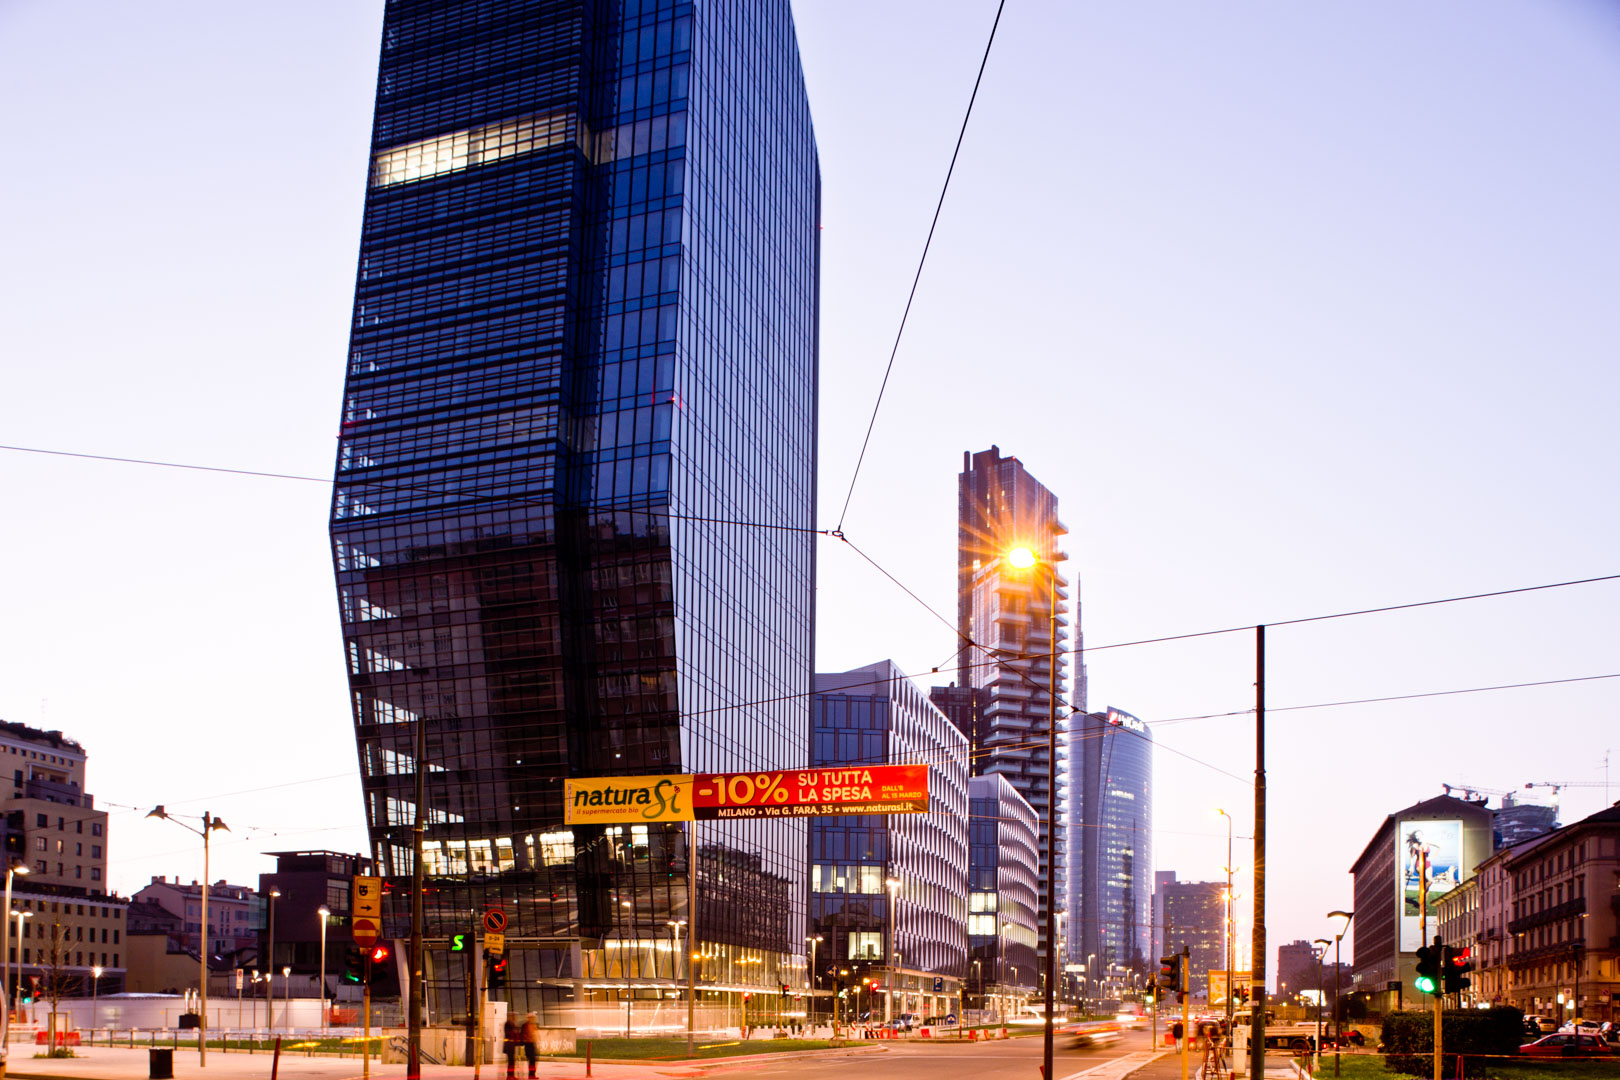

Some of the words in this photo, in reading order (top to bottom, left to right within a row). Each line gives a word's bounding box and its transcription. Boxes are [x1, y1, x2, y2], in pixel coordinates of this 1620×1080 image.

[798, 772, 818, 786] SU
[822, 770, 873, 785] TUTTA
[699, 773, 789, 805] -10%
[799, 788, 819, 802] LA
[822, 786, 872, 801] SPESA
[582, 808, 627, 816] supermercato
[718, 807, 756, 817] MILANO
[765, 807, 780, 815] Via
[782, 806, 791, 815] G.
[793, 805, 820, 815] FARA,
[821, 805, 833, 813] 35
[842, 802, 913, 813] www.naturasi.it
[451, 934, 464, 951] S
[935, 977, 942, 986] P
